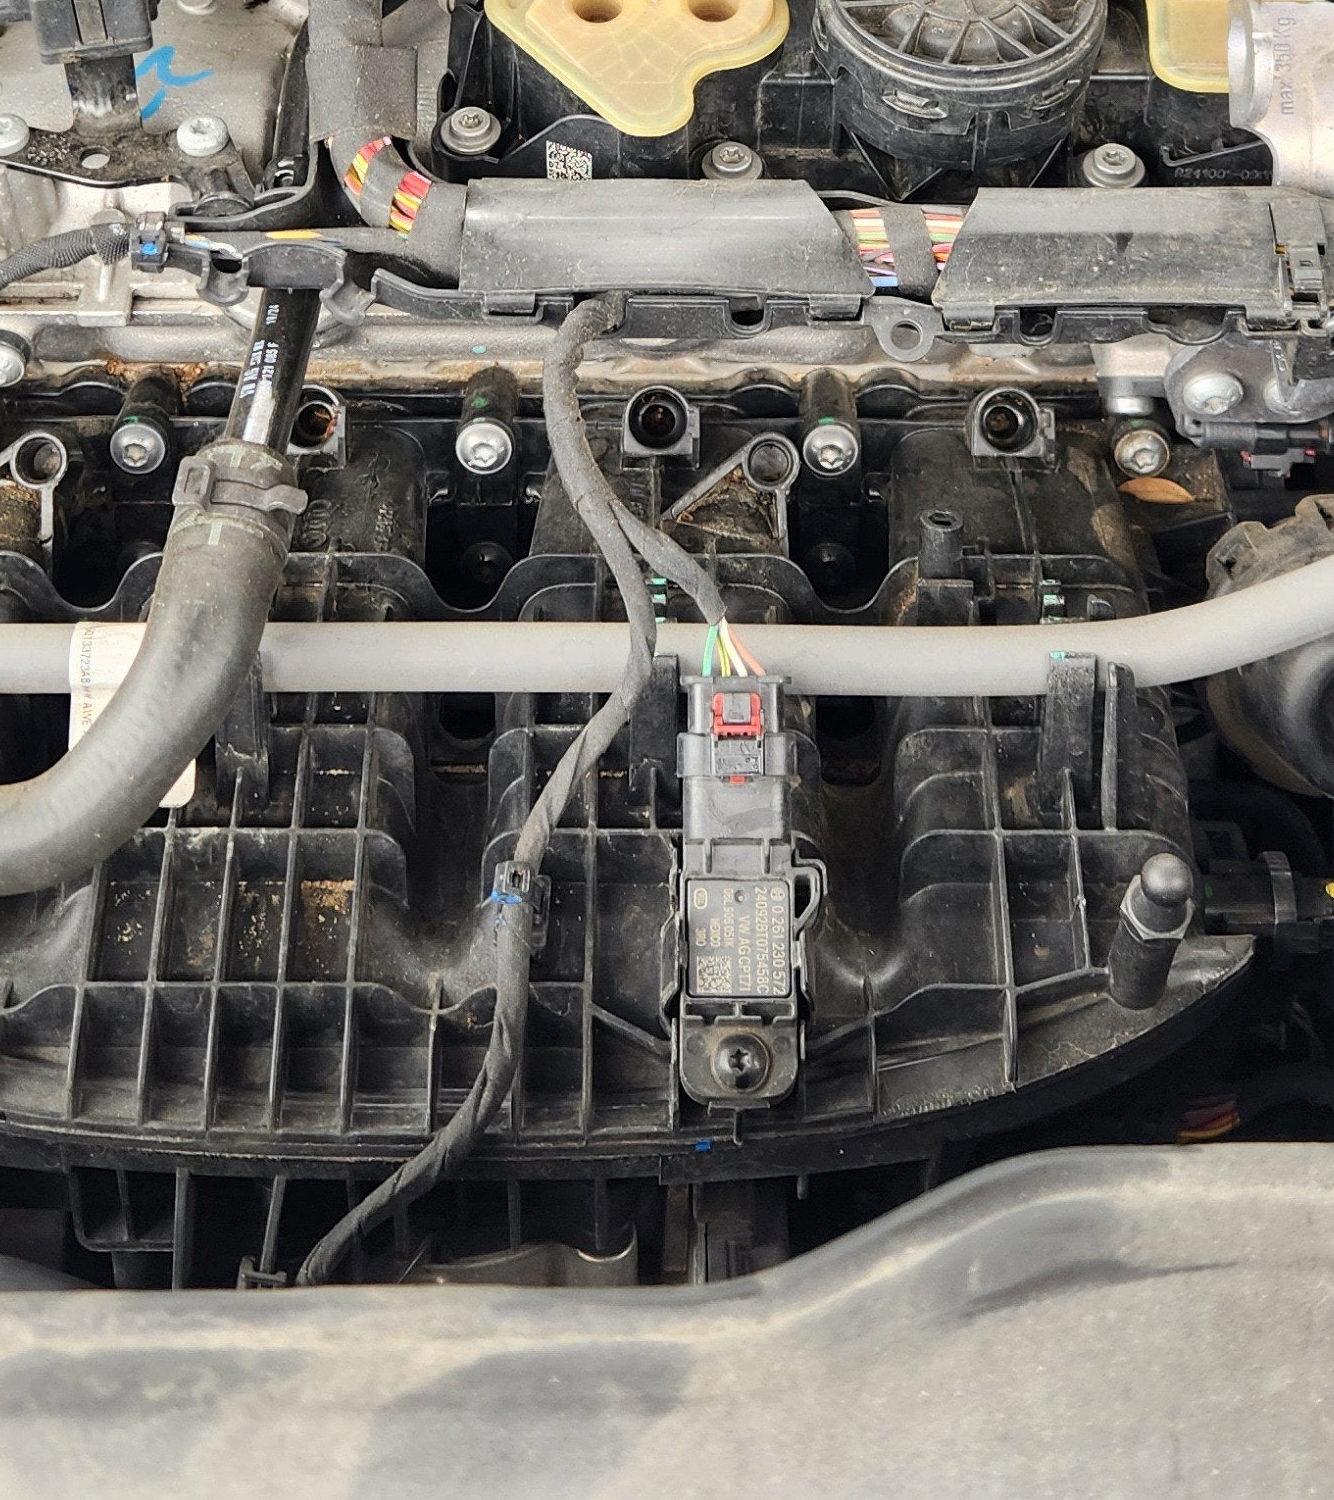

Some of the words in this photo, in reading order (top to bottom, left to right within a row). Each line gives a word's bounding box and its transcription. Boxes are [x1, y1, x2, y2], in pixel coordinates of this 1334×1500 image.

[772, 906, 784, 914] 0
[739, 916, 750, 934] VW
[772, 918, 784, 938] 261
[739, 937, 751, 955] AG
[772, 942, 785, 968] 230
[773, 971, 785, 995] 572
